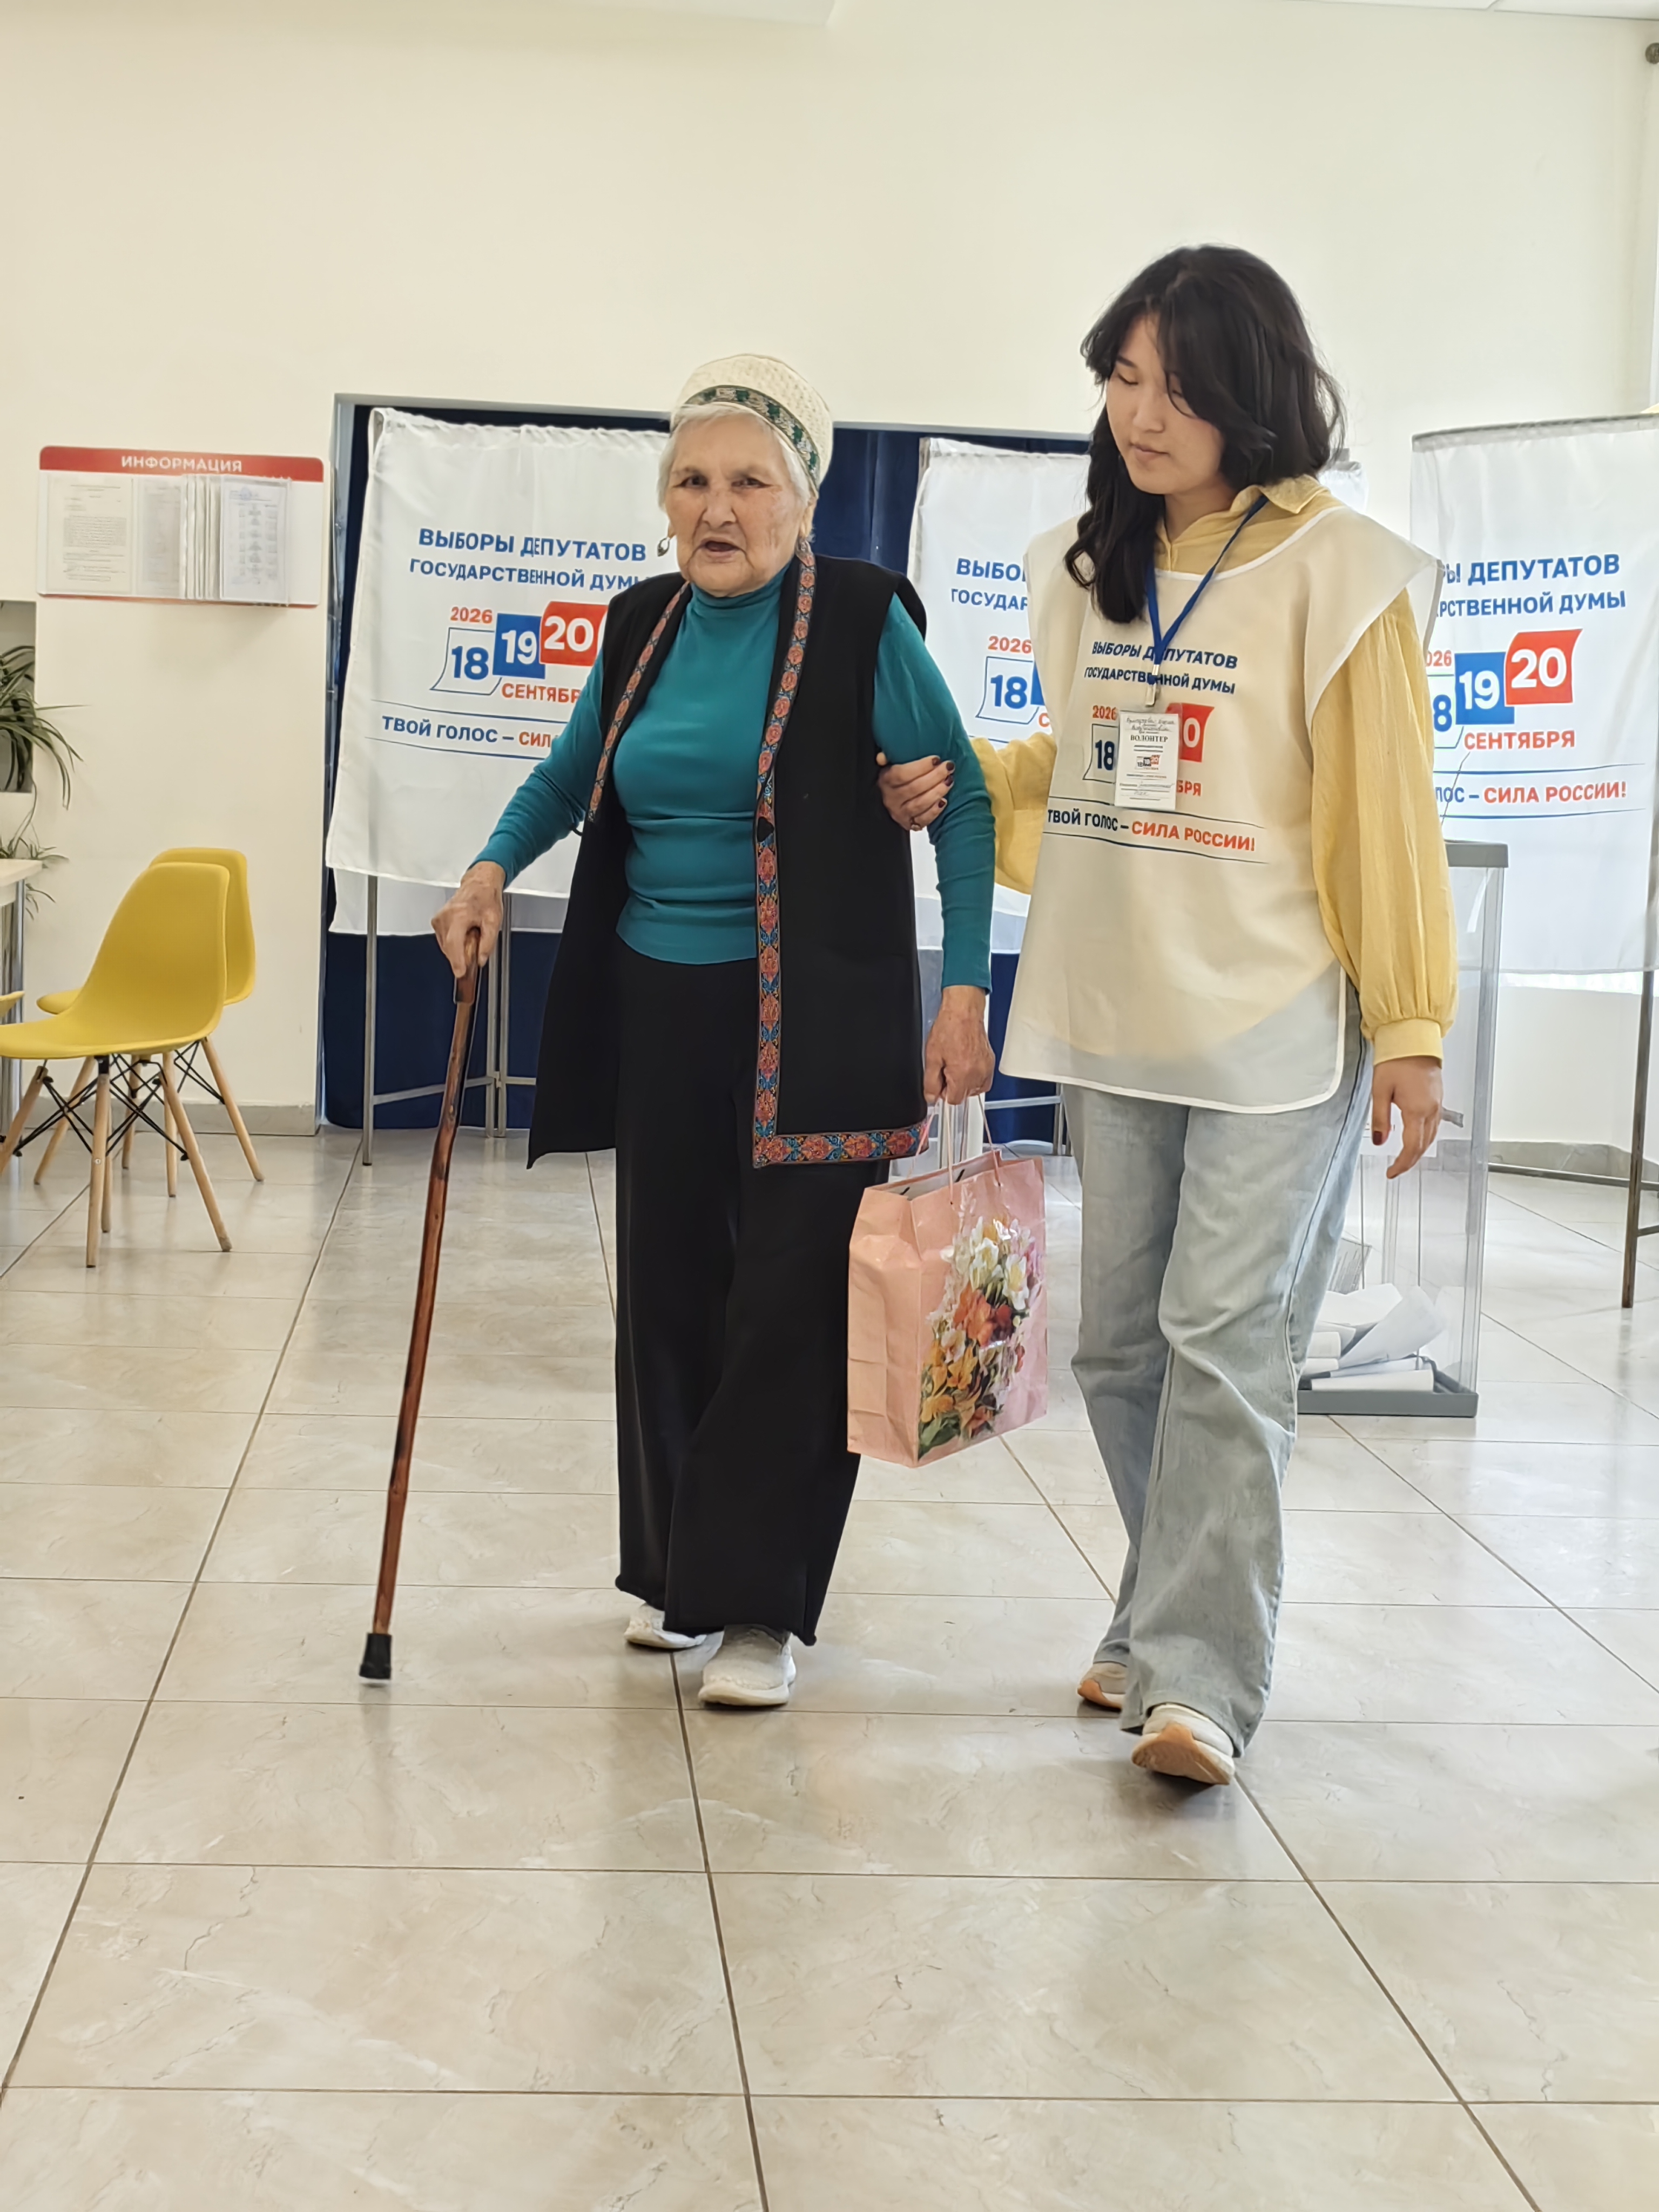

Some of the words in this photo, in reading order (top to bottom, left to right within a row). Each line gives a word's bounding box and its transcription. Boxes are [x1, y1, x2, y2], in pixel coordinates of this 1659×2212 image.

[121, 456, 241, 473] ИНФОРМАЦИЯ
[419, 528, 514, 552] ВЫБОРЫ
[520, 537, 646, 561] ДЕПУТАТОВ
[410, 558, 584, 587] ГОСУДАРСТВЕННОЙ
[956, 558, 1026, 582] ВЫБО
[1468, 554, 1620, 586] ДЕПУТАТОВ
[952, 588, 1028, 611] ГОСУДАР
[1437, 591, 1553, 617] РСТВЕННОЙ
[1559, 590, 1626, 615] ДУМЫ
[450, 606, 493, 623] 2026
[451, 646, 489, 680] 18
[502, 630, 537, 665] 19
[544, 616, 594, 652] 20
[988, 636, 1031, 653] 2026
[1092, 642, 1142, 657] ВЫБОРЫ
[1142, 646, 1238, 669] ДПУТАТОВ
[1426, 649, 1452, 667] 026
[502, 683, 581, 703] СЕНТЯБР
[990, 675, 1027, 709] 18
[1192, 677, 1235, 694] ДУМЫ
[1433, 694, 1452, 732] 8
[1459, 670, 1500, 710] 19
[1511, 648, 1567, 688] 20
[1038, 713, 1049, 727] С
[1092, 705, 1116, 720] 2026
[382, 716, 431, 736] ТВОЙ
[437, 725, 498, 743] ГОЛОС
[519, 732, 558, 747] СИЛ
[1464, 730, 1575, 750] СЕНТЯБРЯ
[1095, 739, 1115, 771] 18
[1183, 718, 1201, 748] 0
[1177, 780, 1201, 797] БРЯ
[1435, 787, 1465, 802] ЛОС
[1484, 786, 1539, 804] СИЛА
[1546, 781, 1626, 802] РОССИИ!
[1048, 808, 1080, 825] ТВОЙ
[1085, 813, 1118, 831] ГОЛОС
[1132, 821, 1179, 840] СИЛА
[1184, 827, 1255, 851] РОССИИ!
